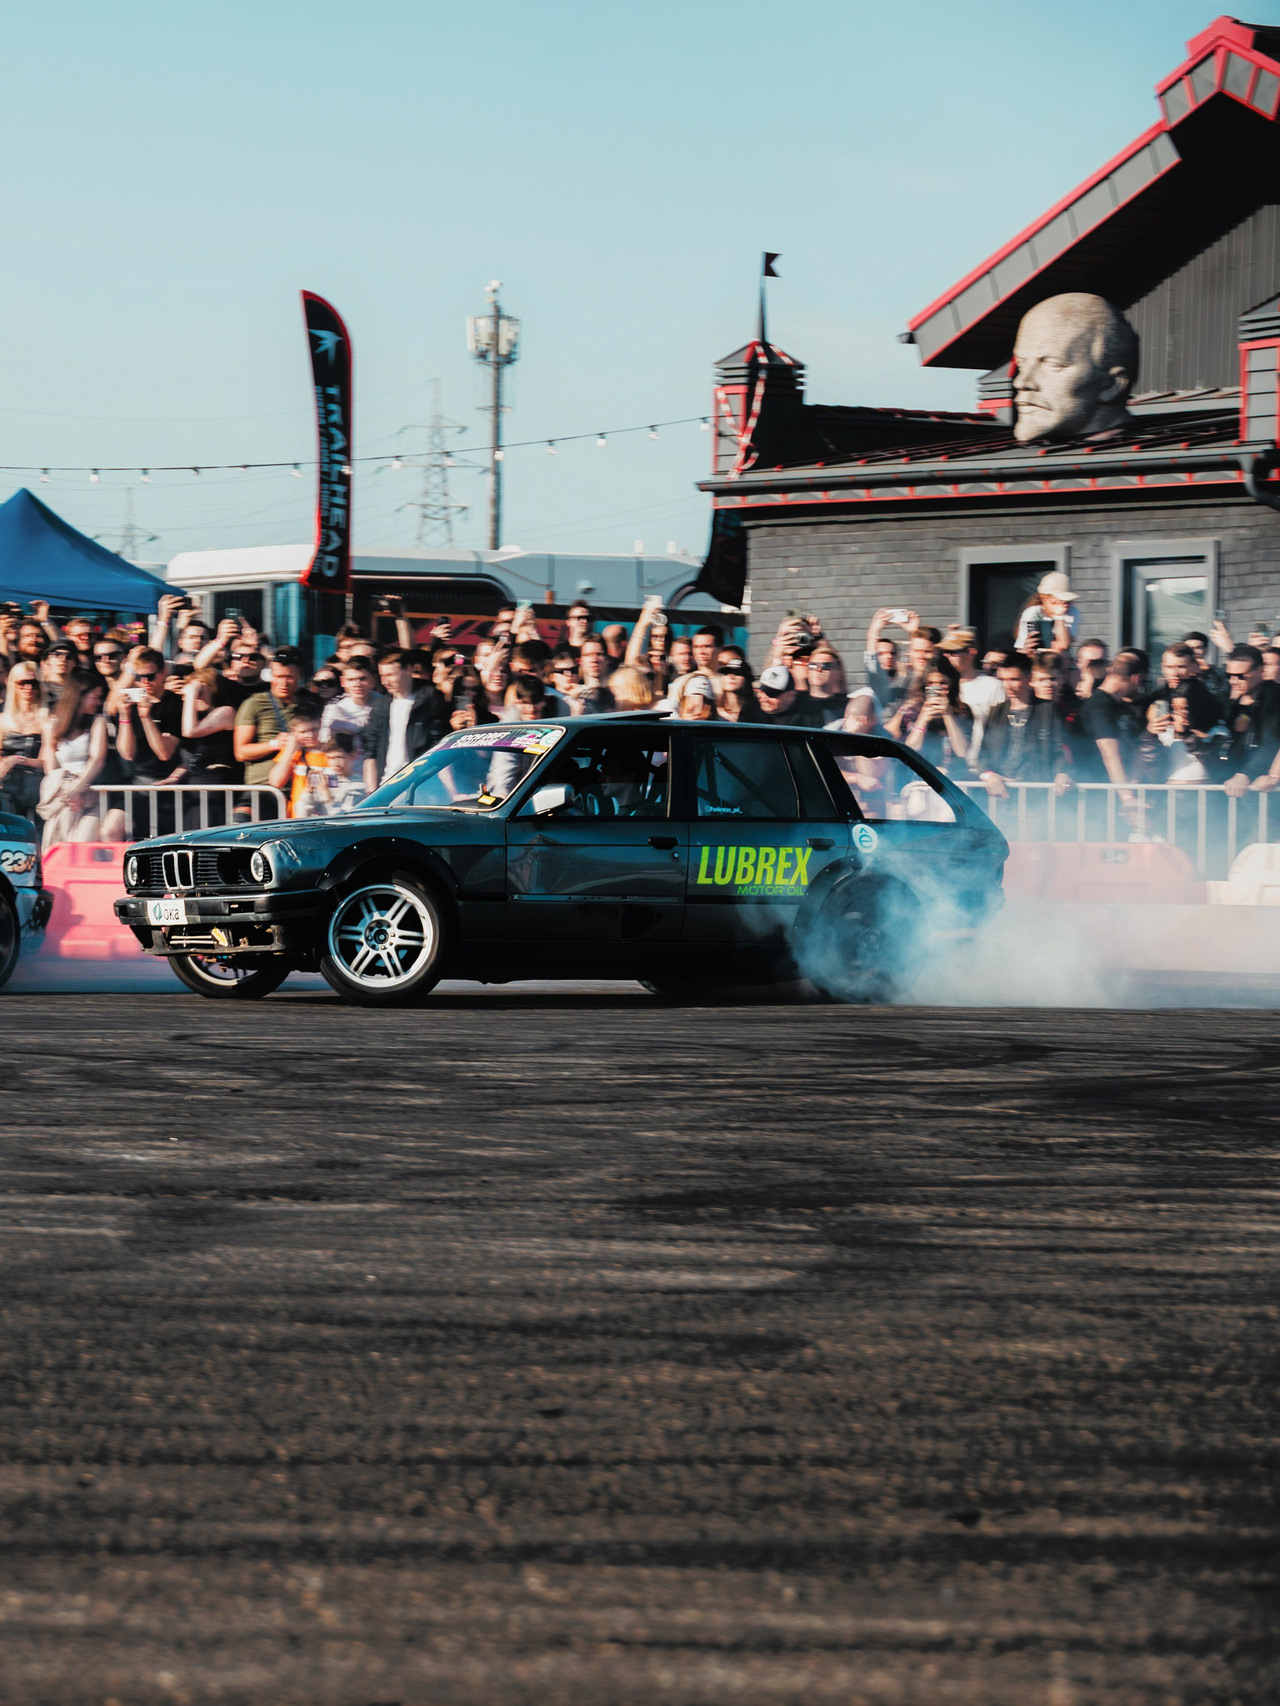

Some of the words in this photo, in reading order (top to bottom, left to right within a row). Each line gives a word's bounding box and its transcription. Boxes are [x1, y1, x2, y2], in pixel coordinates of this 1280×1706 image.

[321, 384, 348, 577] TRAILHEAD
[0, 850, 27, 873] 23
[697, 846, 813, 886] LUBREX
[737, 885, 784, 895] MOTOR
[786, 885, 806, 895] OIL
